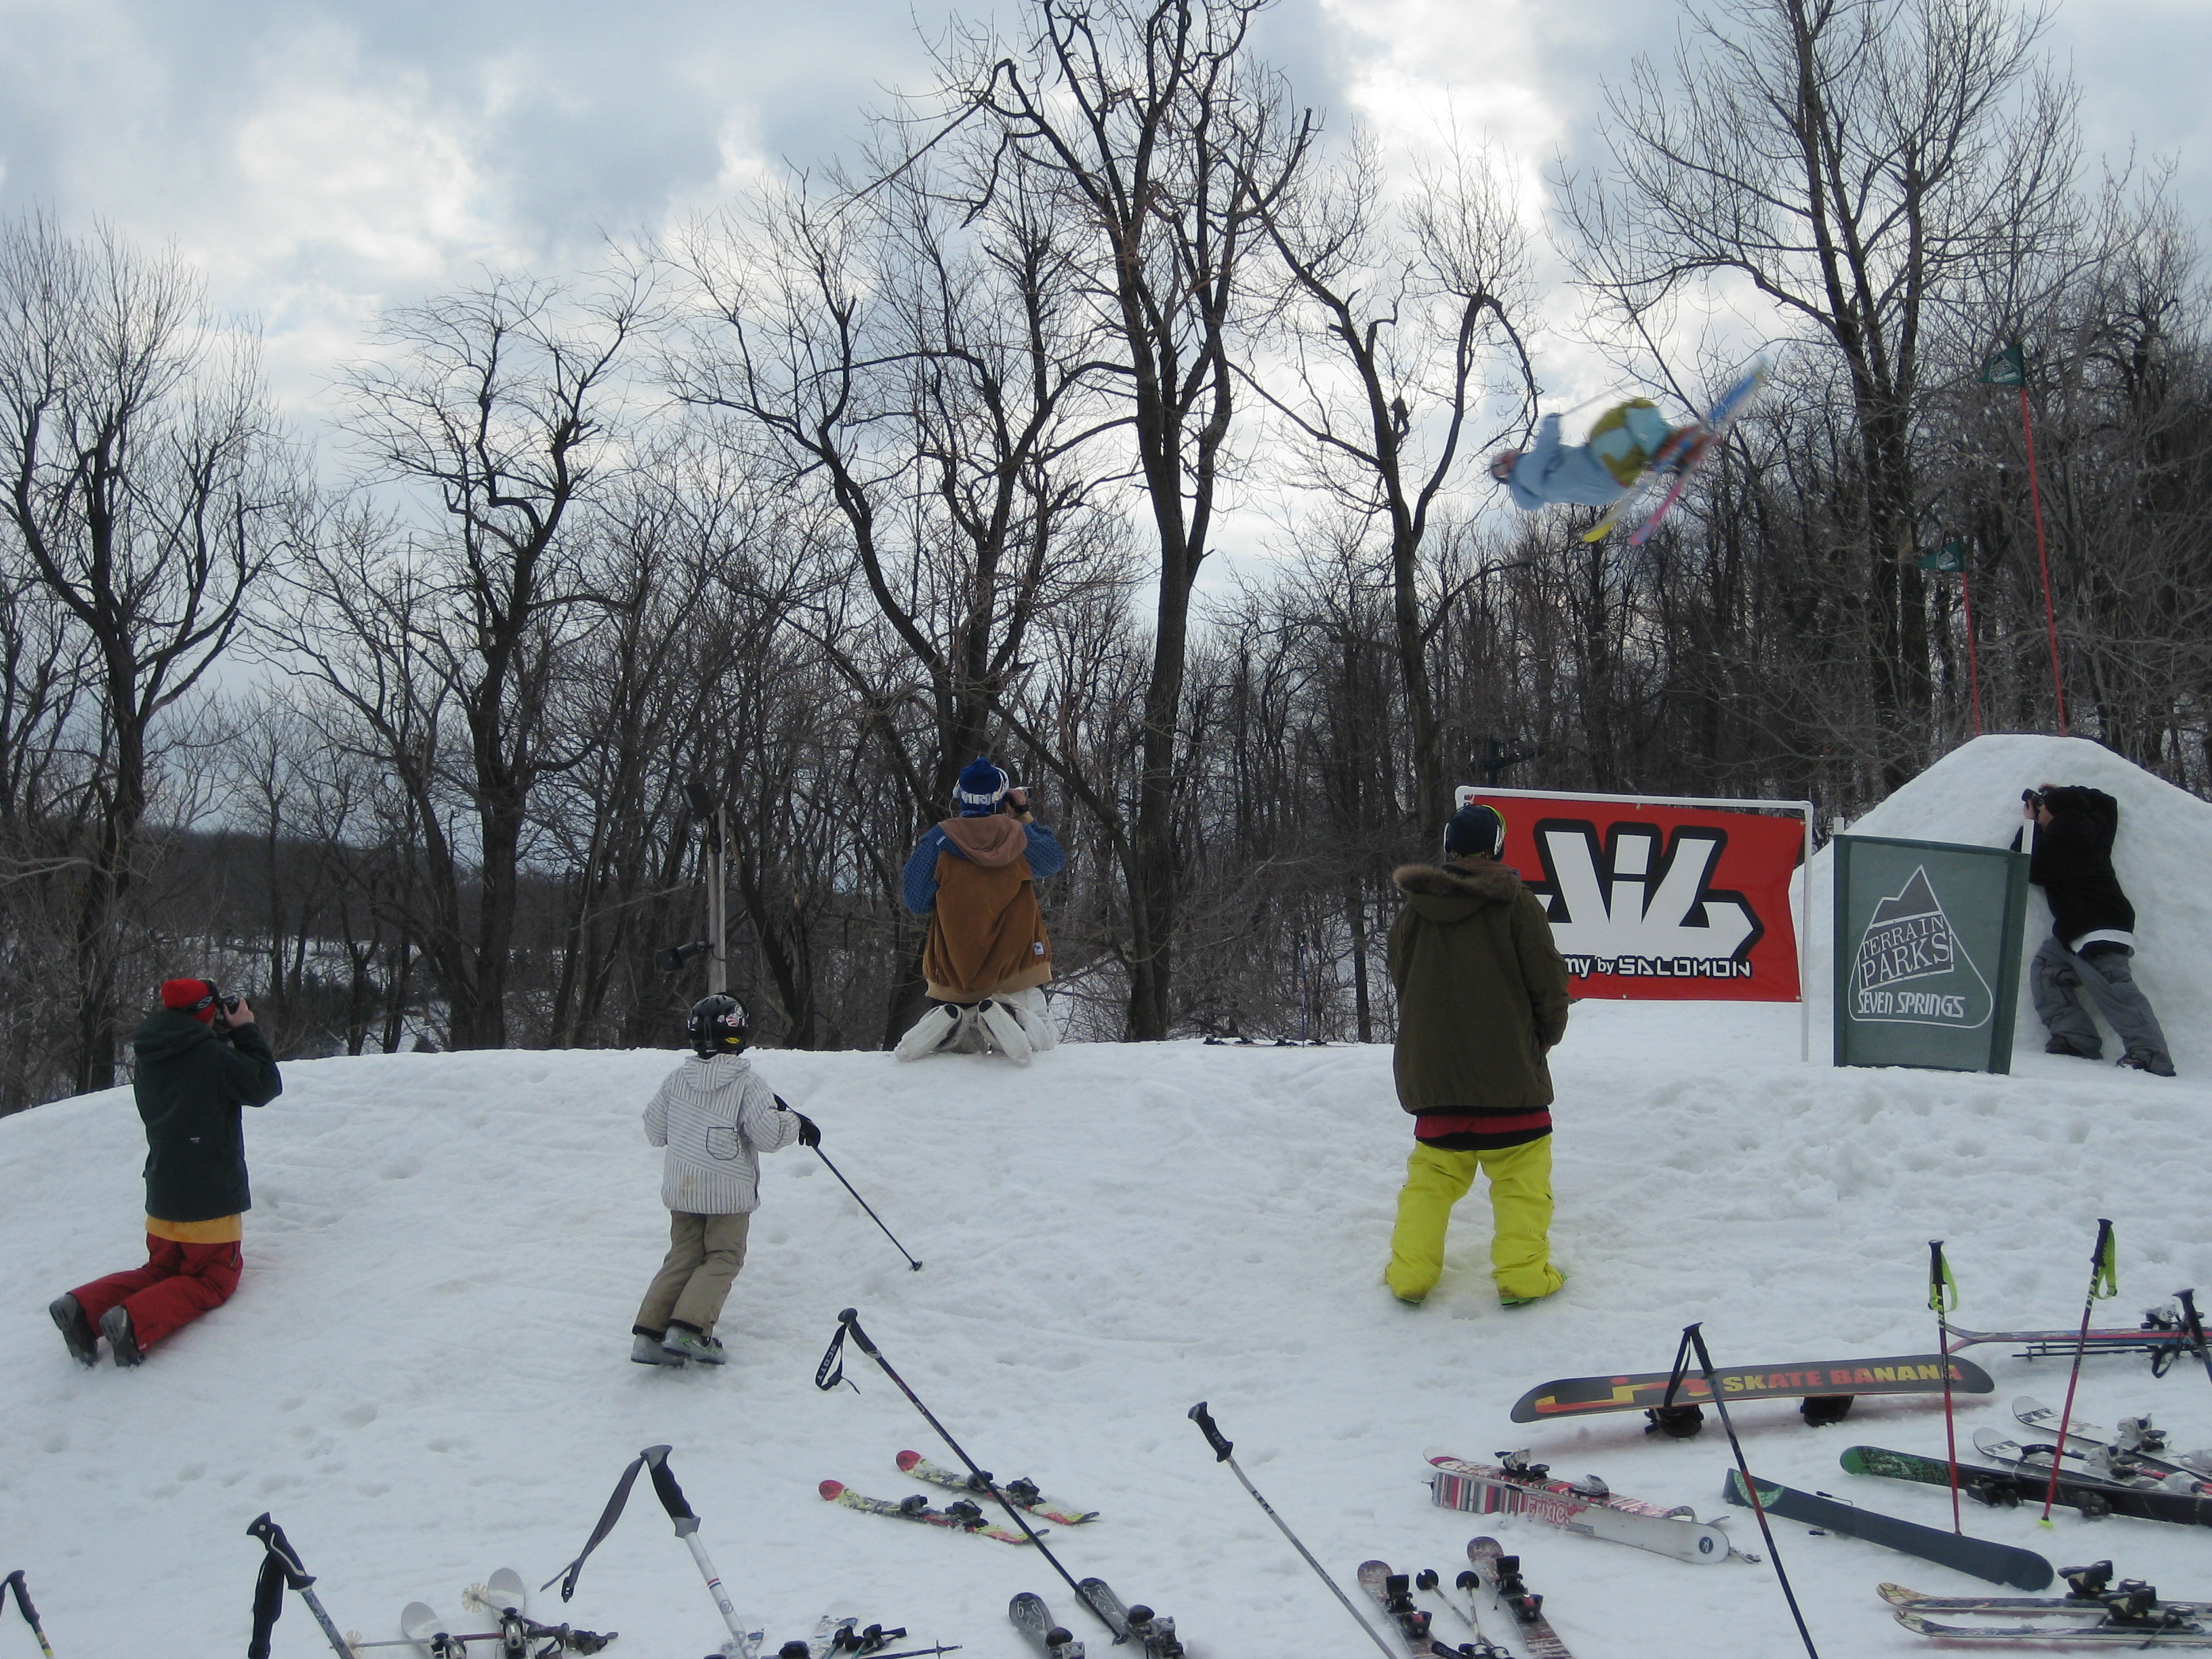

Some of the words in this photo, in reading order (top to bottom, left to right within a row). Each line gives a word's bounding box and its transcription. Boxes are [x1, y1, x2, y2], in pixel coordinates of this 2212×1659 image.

[1862, 916, 1944, 960] TERRAIN
[1597, 958, 1615, 975] by
[1618, 958, 1750, 977] SALOMON
[1862, 931, 1950, 987] PARKS
[1858, 991, 1893, 1016] SEVEN
[1896, 991, 1965, 1019] SPRINGS
[817, 1344, 838, 1382] SCOTT
[1723, 1370, 1823, 1393] SKATE
[1830, 1364, 1963, 1386] BANANA
[1212, 1431, 1227, 1450] LEKI
[1252, 1490, 1275, 1515] LEKI
